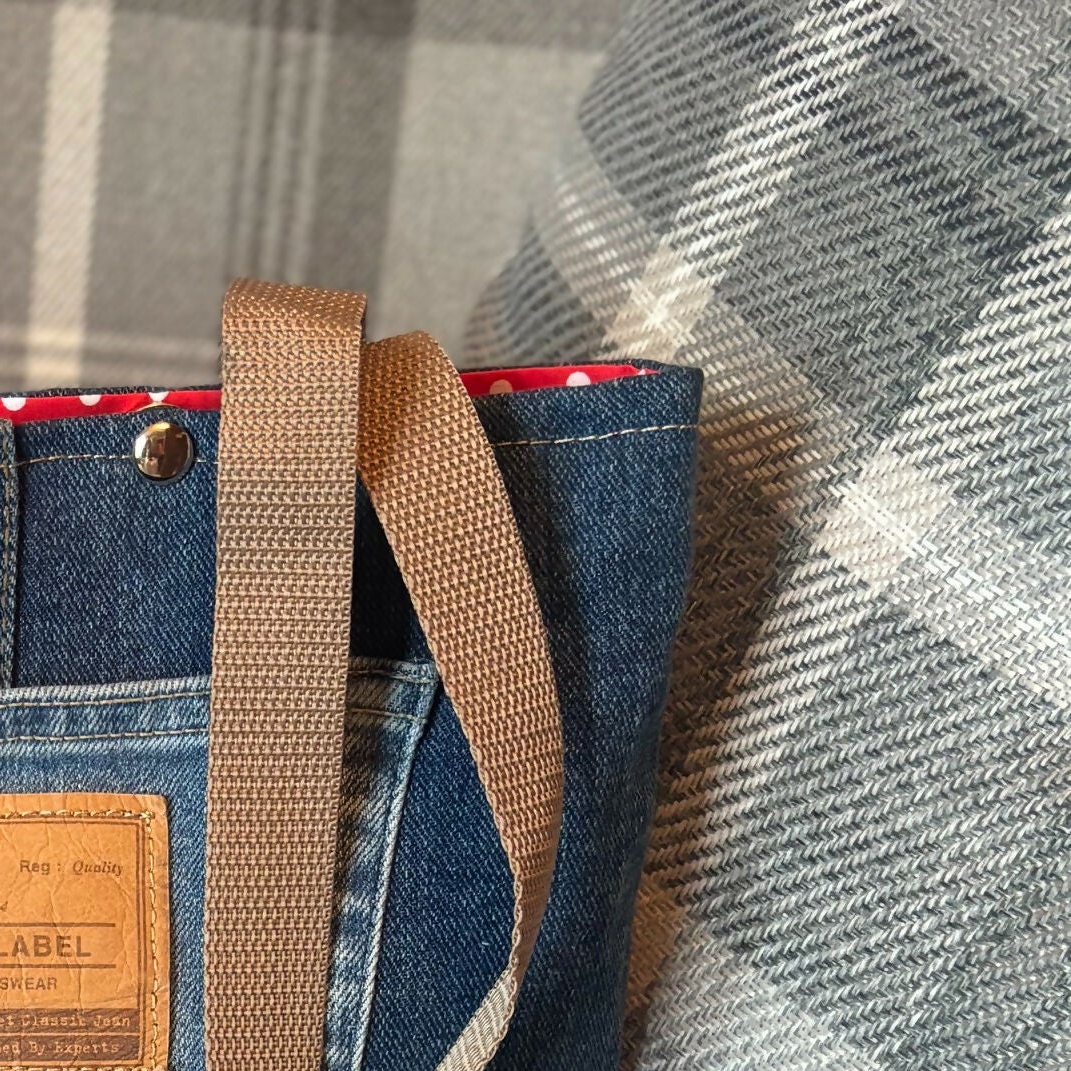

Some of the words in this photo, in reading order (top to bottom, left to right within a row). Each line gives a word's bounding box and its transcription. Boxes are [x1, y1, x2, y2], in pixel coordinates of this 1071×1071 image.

[72, 861, 124, 877] Quality
[21, 1014, 87, 1027] Classic
[94, 1014, 131, 1028] Jean
[30, 1043, 46, 1056] By
[55, 1041, 120, 1056] Experts
